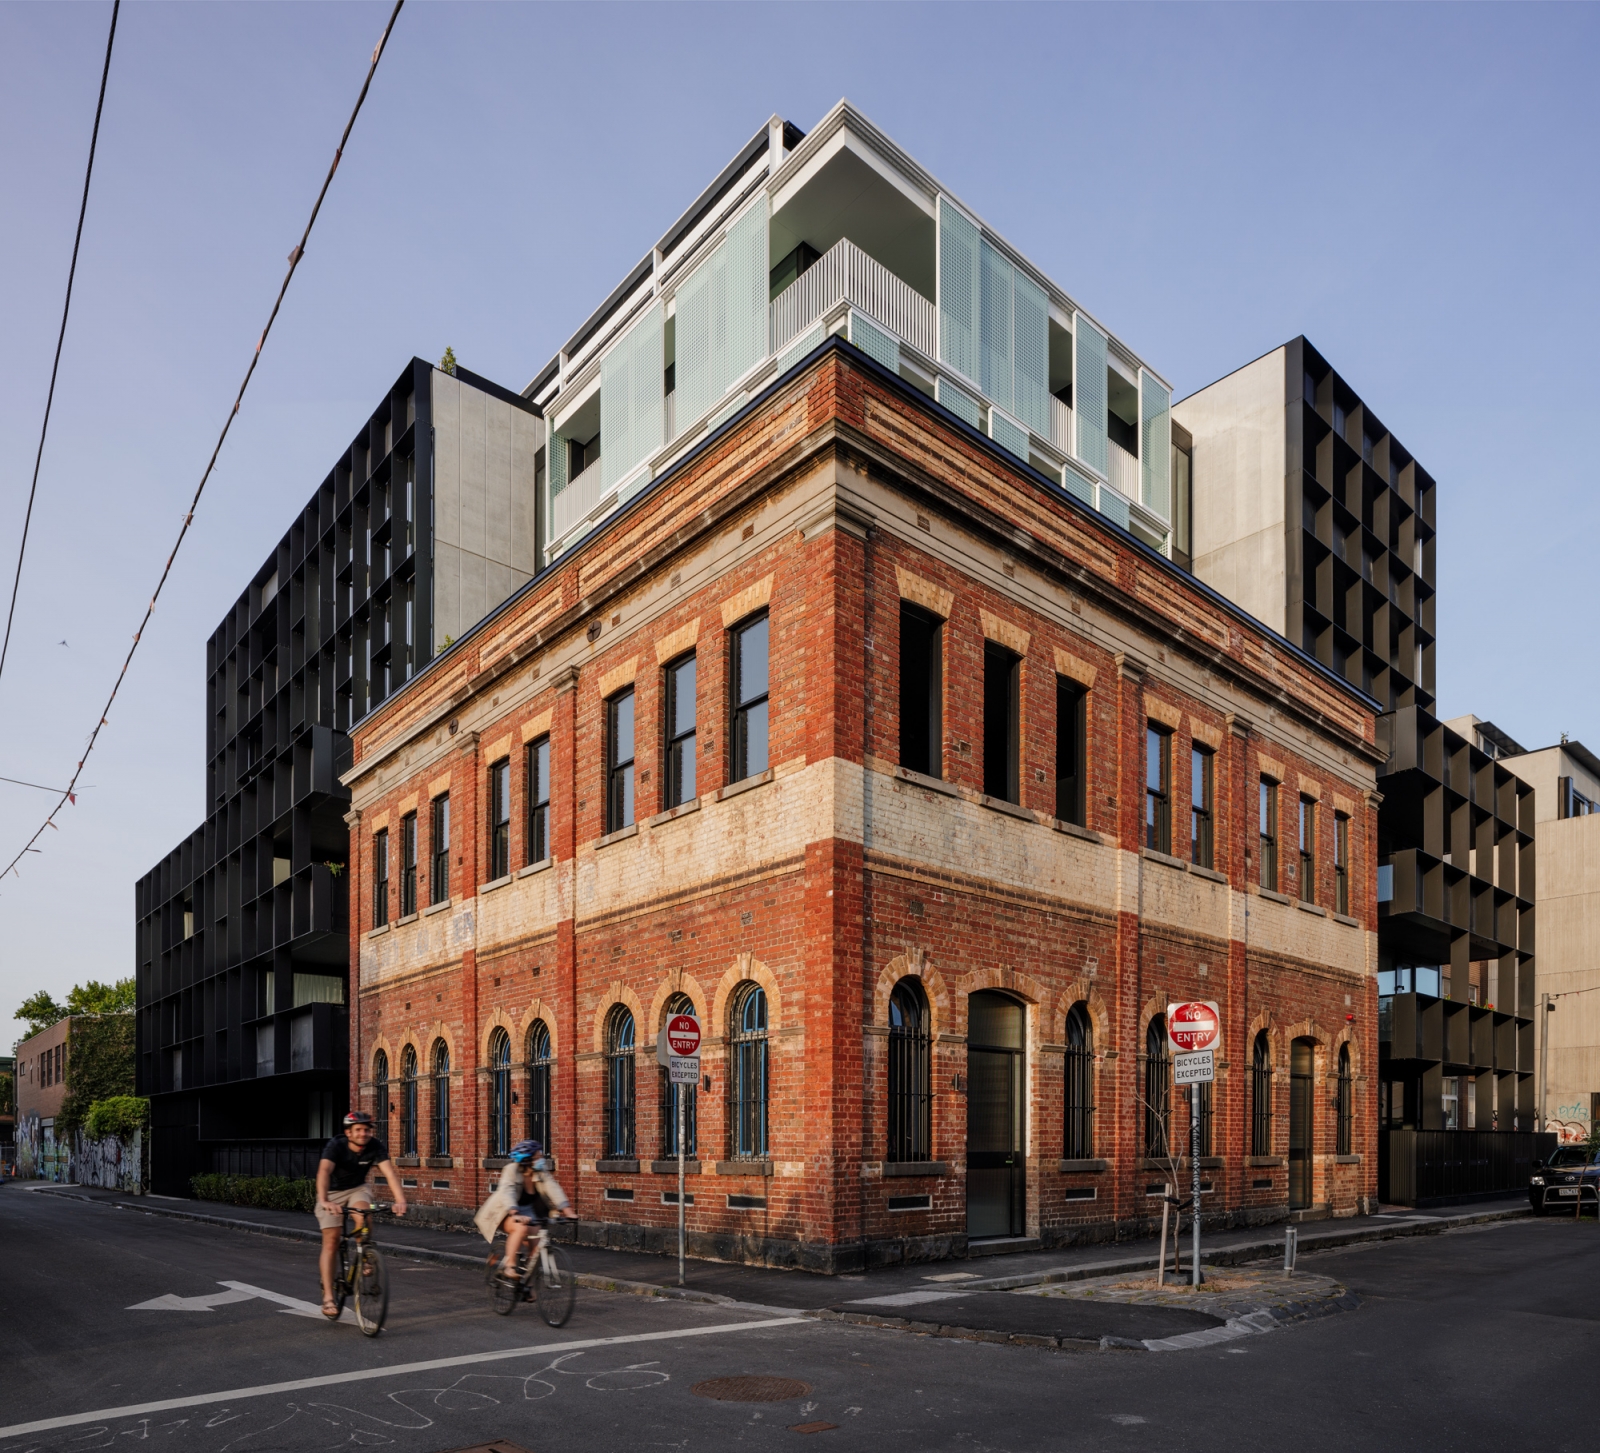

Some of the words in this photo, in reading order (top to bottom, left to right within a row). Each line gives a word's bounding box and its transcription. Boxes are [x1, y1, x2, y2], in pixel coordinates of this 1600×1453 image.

[1186, 1011, 1201, 1020] NO
[679, 1022, 689, 1030] NO
[1177, 1032, 1211, 1042] ENTRY
[672, 1040, 695, 1049] ENTRY
[1177, 1056, 1210, 1067] BICYCLES
[1177, 1068, 1211, 1078] EXCEPTED
